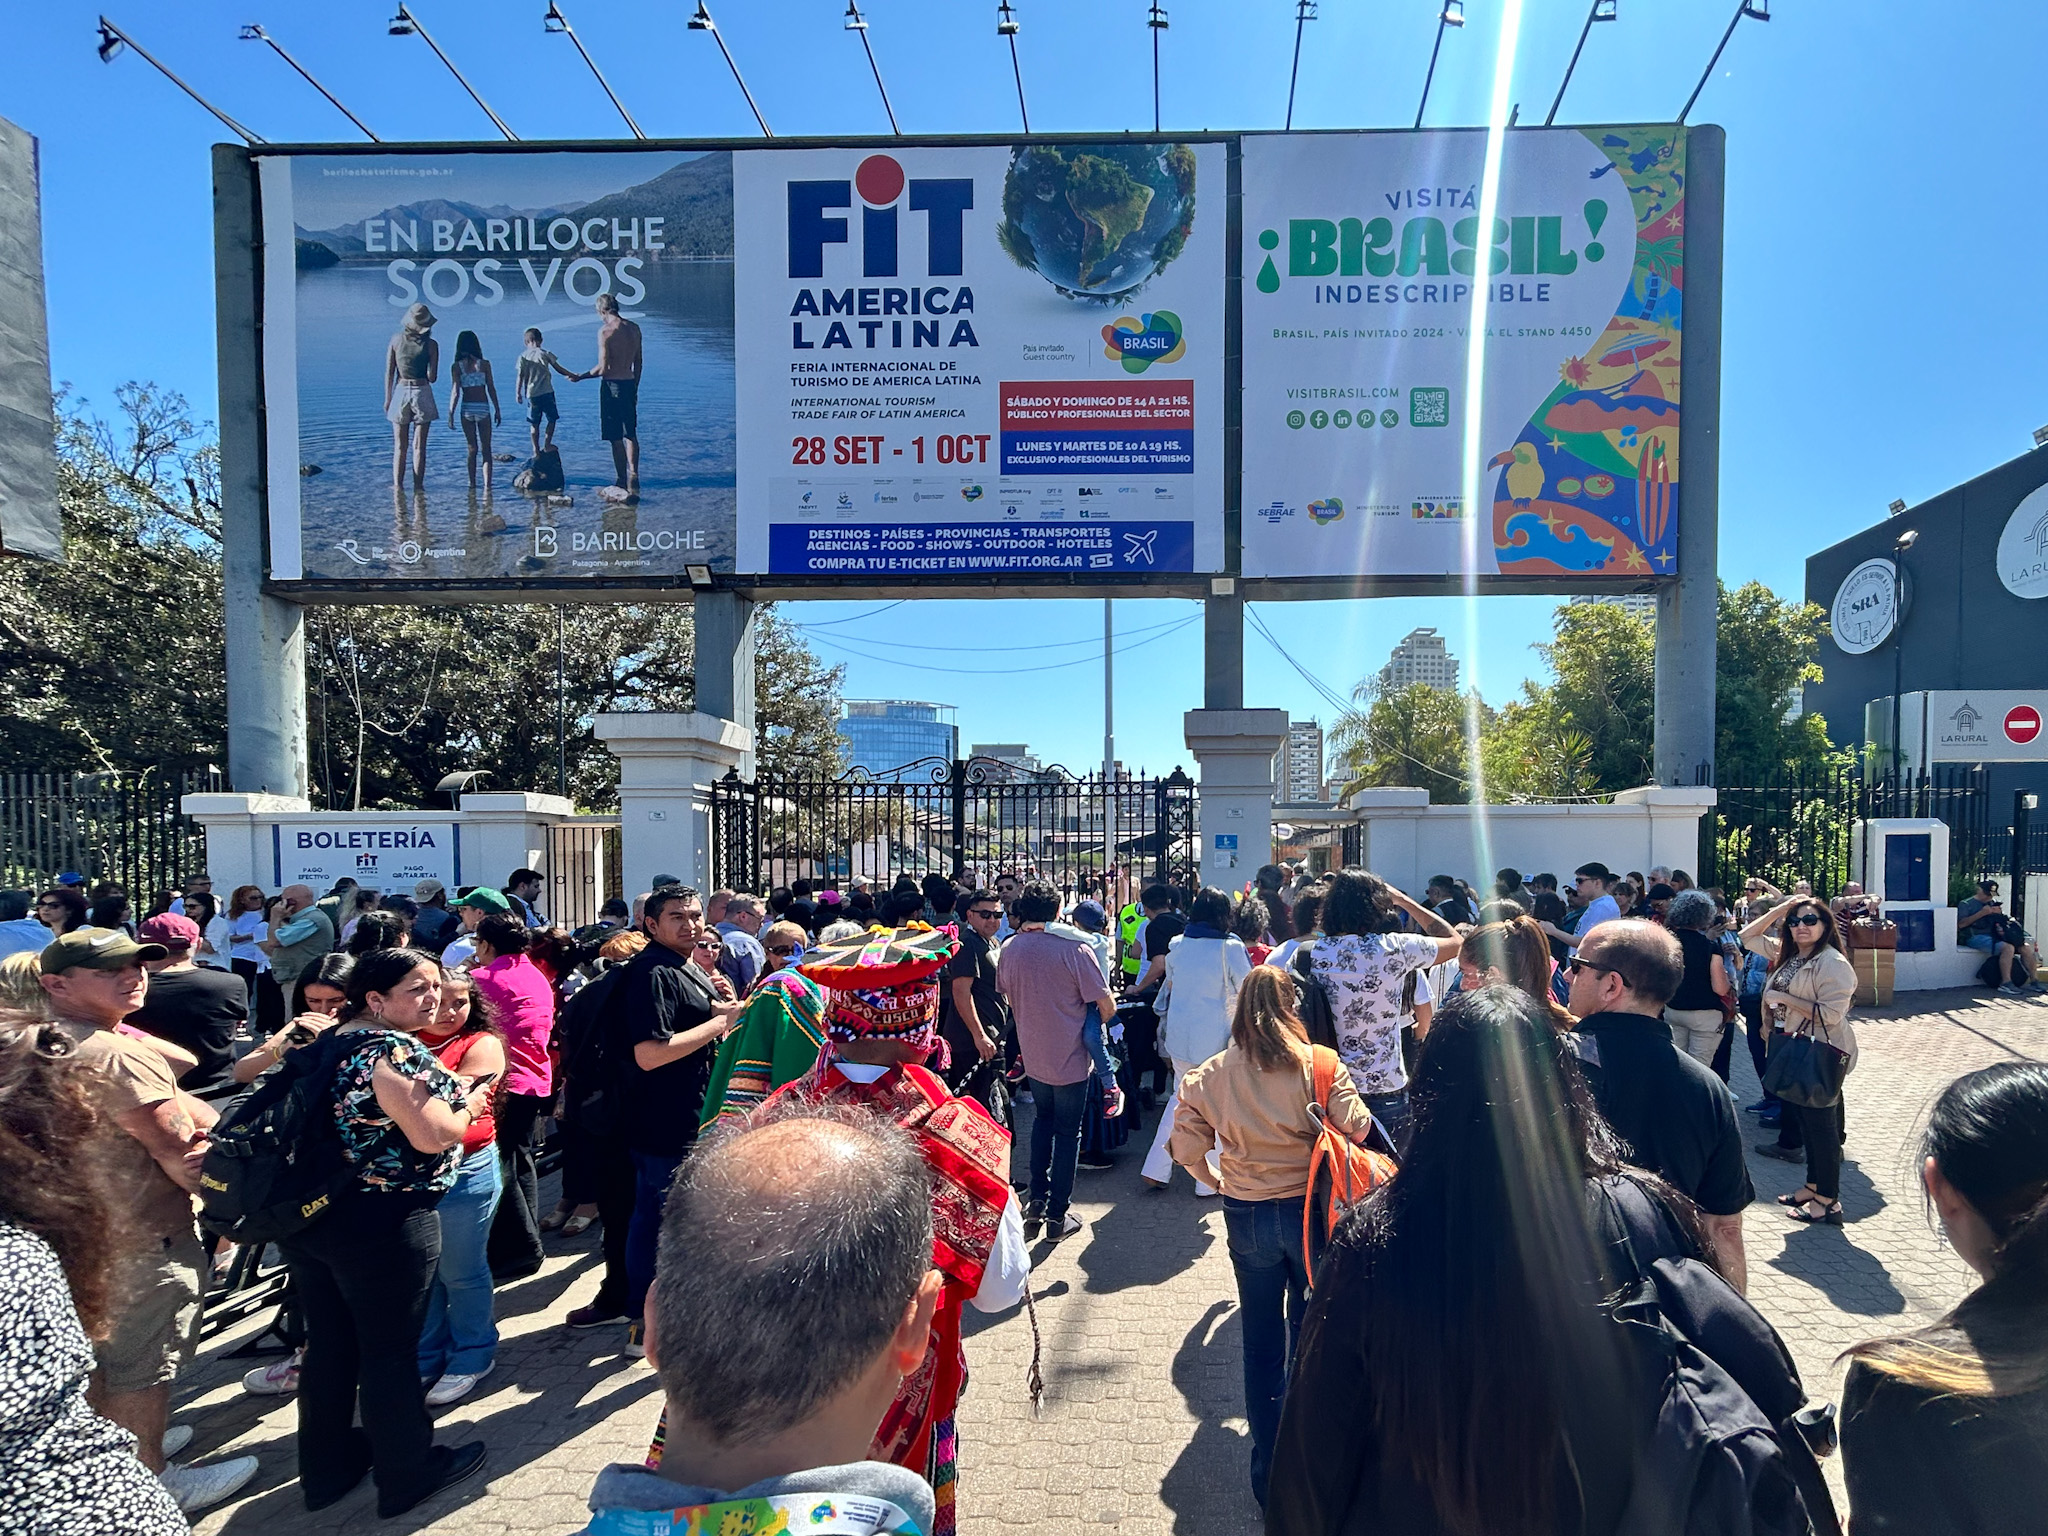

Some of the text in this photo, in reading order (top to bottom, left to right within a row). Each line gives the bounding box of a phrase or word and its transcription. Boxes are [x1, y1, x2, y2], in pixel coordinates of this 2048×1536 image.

[1385, 184, 1477, 211] VISITÁ
[365, 216, 666, 253] EN BARILOCHE
[386, 256, 647, 308] SOS VOS
[1315, 283, 1551, 304] INDESCRIPIBLE
[789, 286, 974, 317] AMERICA
[792, 319, 980, 350] LATINA
[1413, 327, 1444, 338] 2024
[1560, 326, 1592, 337] 4450
[1123, 337, 1169, 350] BRASIL
[1022, 352, 1076, 362] Guest country
[790, 361, 957, 372] FERIA INTERNACIONAL DE
[790, 375, 982, 387] TURISMO DE AMERICA LATINA
[1286, 388, 1400, 399] VISITBRASIL.COM
[790, 397, 936, 407] INTERNATIONAL TOURISM
[1006, 395, 1190, 407] SÁBADO Y DOMINGO DE 14 A 21 HS.
[791, 409, 966, 420] TRADE FAIR OF LATIN AMERICA
[1007, 408, 1190, 419] PÚBLICO Y PROFESIONALES DEL SECTOR
[792, 436, 826, 465] 28
[833, 436, 885, 465] SET
[911, 436, 924, 464] 1
[936, 434, 992, 464] OCT
[1016, 440, 1182, 452] LUNES Y MARTES DE 10 A 19 HS.
[1007, 454, 1192, 464] EXCLUSIVO PROFESIONALES DEL TURISMO
[1258, 508, 1296, 516] SEBRAE
[1316, 508, 1337, 516] BRASIL
[808, 529, 871, 540] DESTINOS
[882, 527, 924, 539] PAÍSES
[934, 528, 1010, 538] PROVINCIAS
[1020, 528, 1111, 538] TRANSPORTES
[572, 530, 706, 551] BARILOCHE
[806, 540, 870, 551] AGENCIAS
[880, 540, 916, 550] FOOD
[925, 540, 972, 550] SHOWS
[983, 539, 1046, 549] OUTDOOR
[1056, 538, 1112, 549] HOTELES
[424, 548, 466, 558] Argentina
[572, 560, 608, 568] Patagonia
[614, 559, 650, 567] Argentina
[808, 556, 1083, 570] COMPRA TU E-TICKET EN WWW.FIT.ORG.AR
[1851, 592, 1880, 615] SRA
[1954, 734, 1989, 742] RURAL
[296, 826, 436, 849] BOLETERÍA
[301, 1194, 329, 1218] CAT
